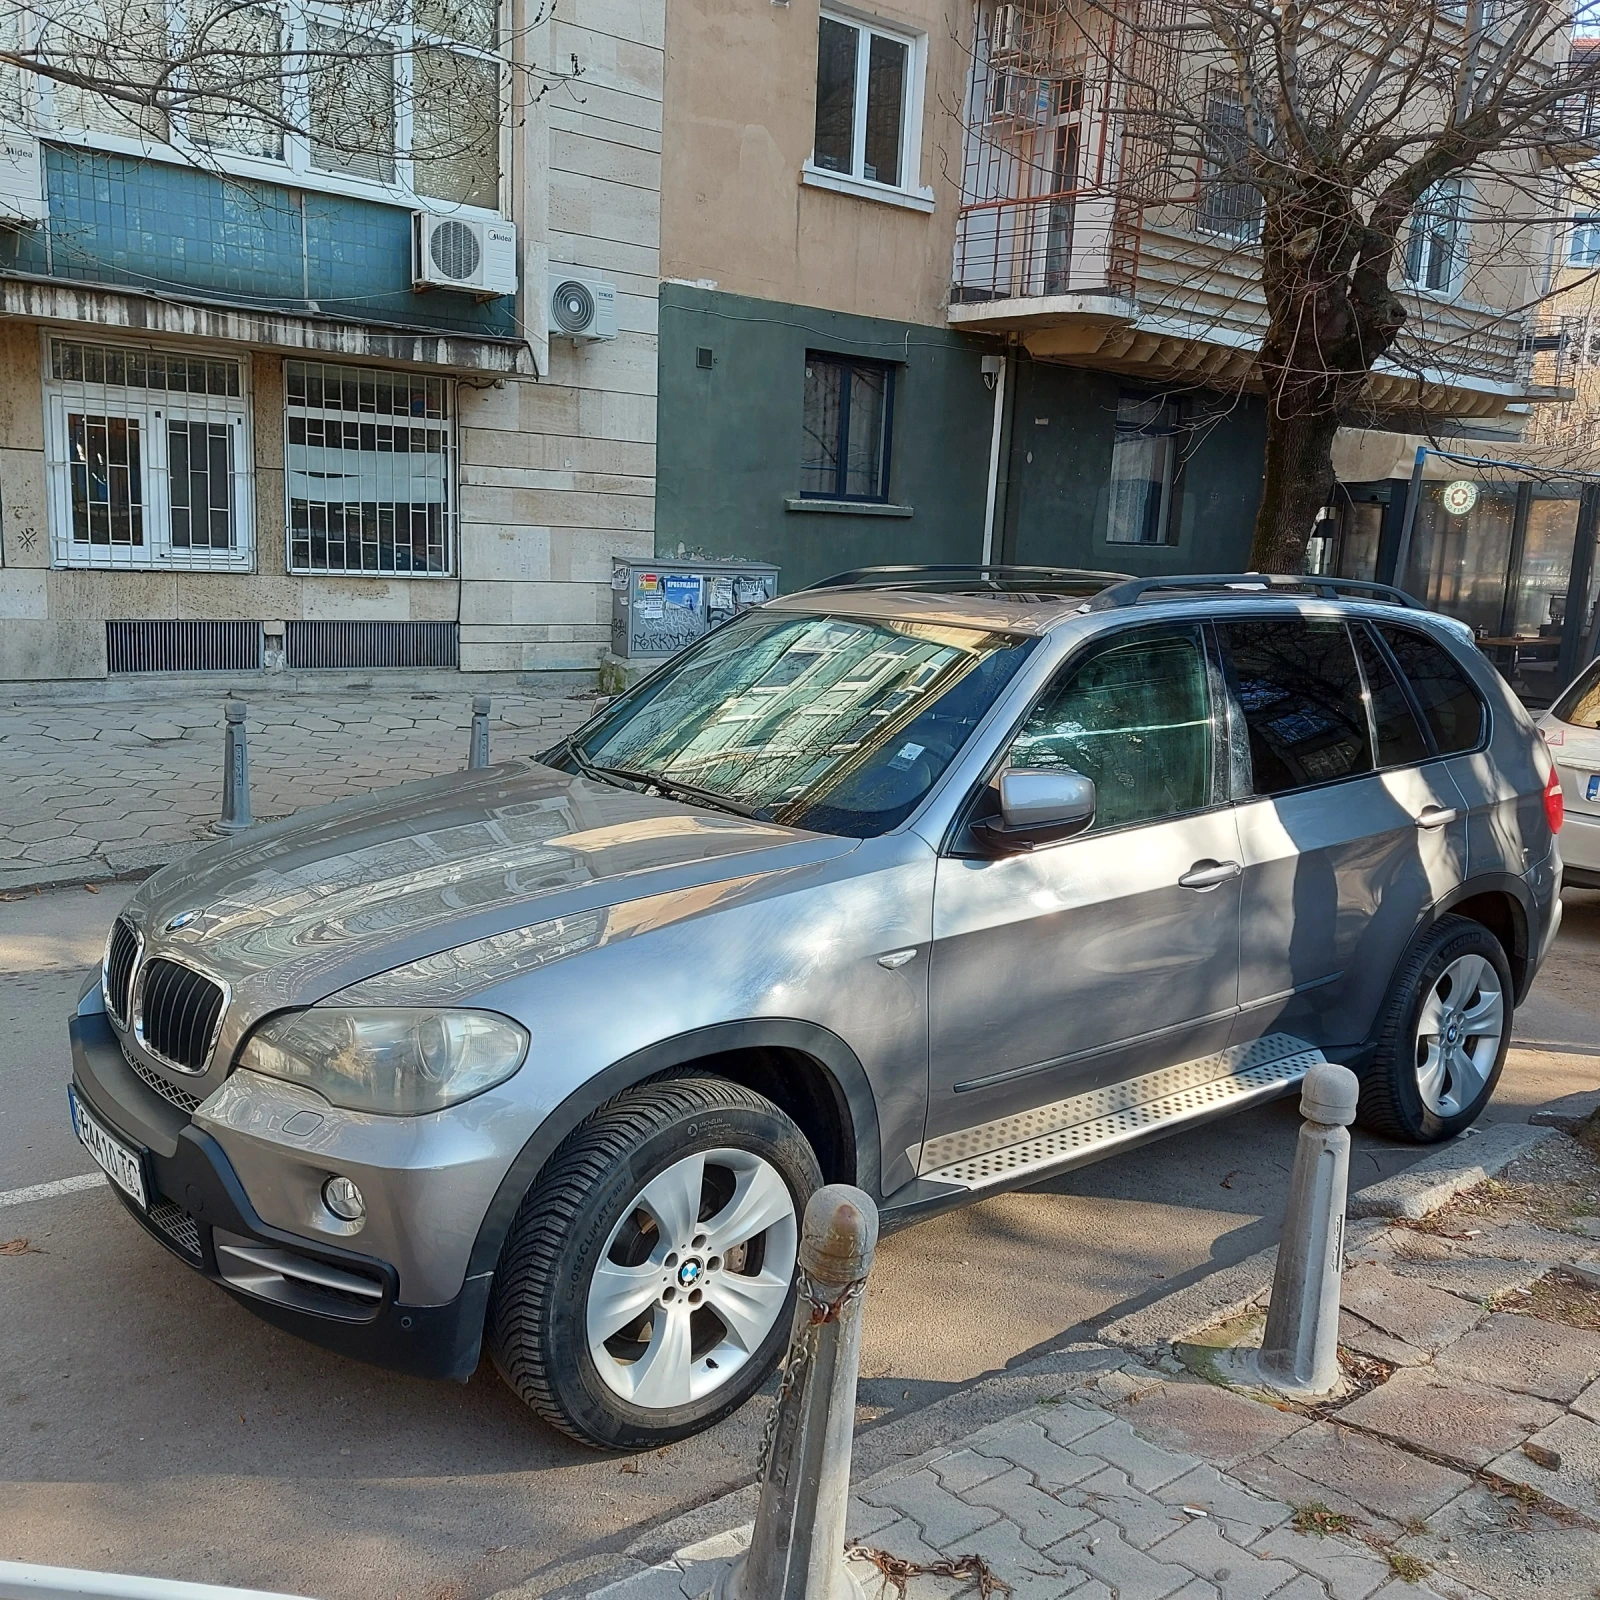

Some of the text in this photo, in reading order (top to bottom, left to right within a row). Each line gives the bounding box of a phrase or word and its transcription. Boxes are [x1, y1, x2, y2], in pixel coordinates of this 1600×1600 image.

[490, 231, 513, 243] Midea
[700, 1117, 723, 1128] MICHELIN
[566, 1197, 617, 1302] CROSSCLIMATE
[613, 1177, 628, 1198] SUV
